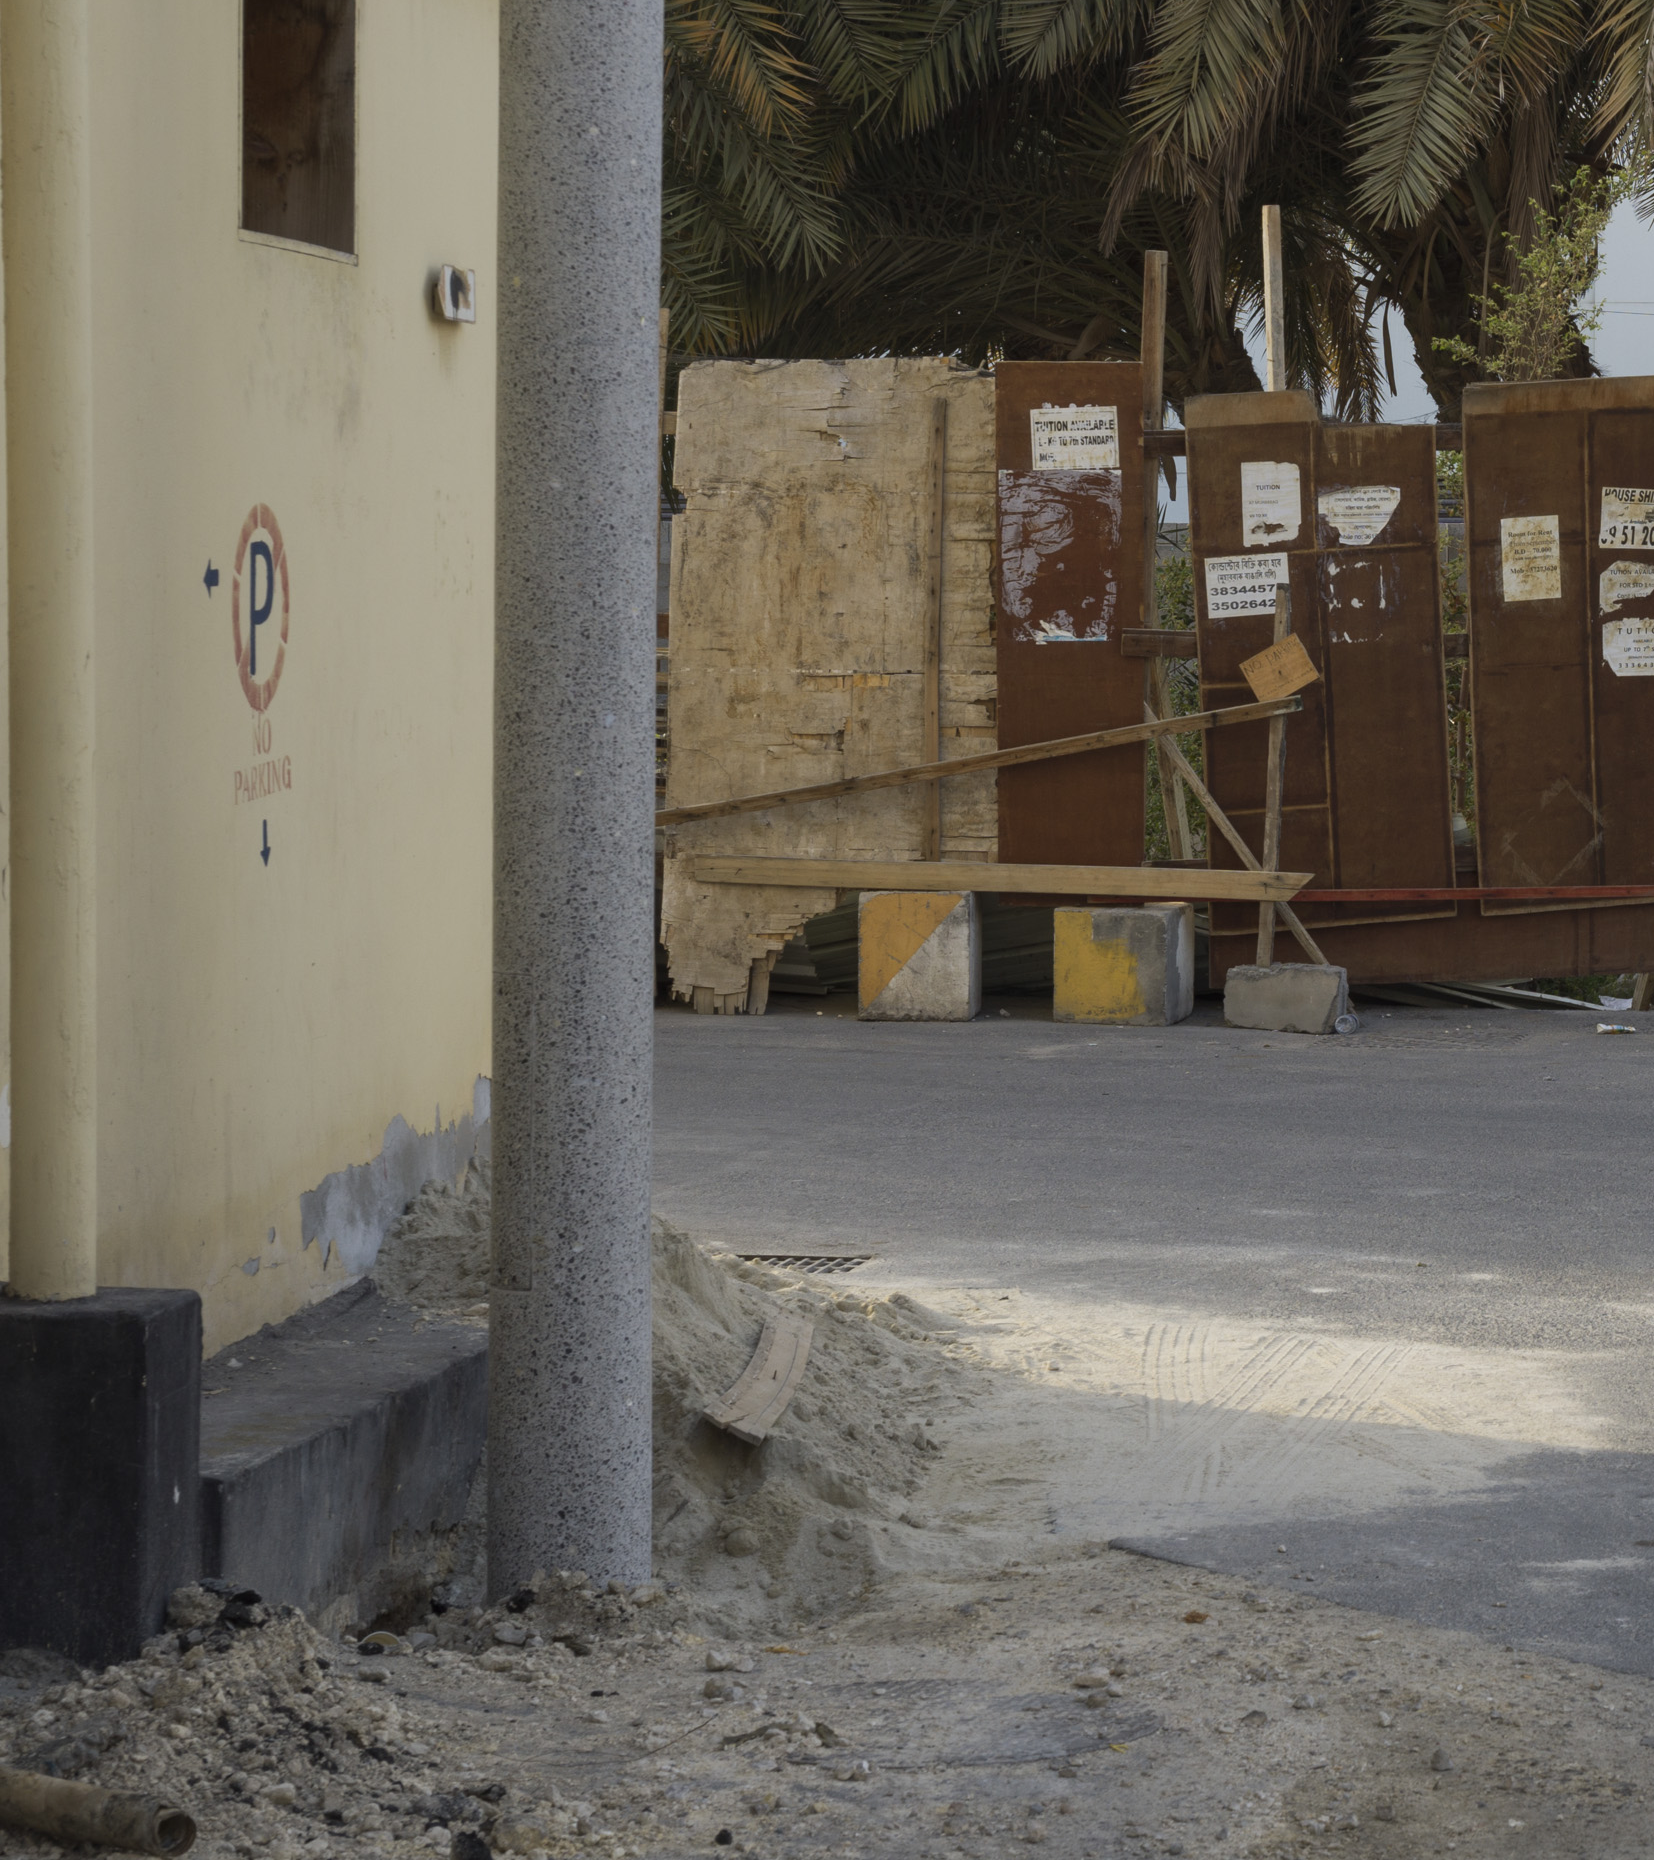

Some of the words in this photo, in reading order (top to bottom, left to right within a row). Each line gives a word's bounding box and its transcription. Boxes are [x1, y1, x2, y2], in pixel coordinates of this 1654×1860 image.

[1035, 420, 1068, 432] TUITION
[1621, 525, 1635, 545] 51
[1210, 584, 1275, 596] 3834457
[250, 540, 274, 676] P
[1211, 599, 1276, 611] 3502642
[1244, 660, 1262, 677] NO
[252, 716, 271, 756] NO
[233, 755, 292, 805] PARKING
